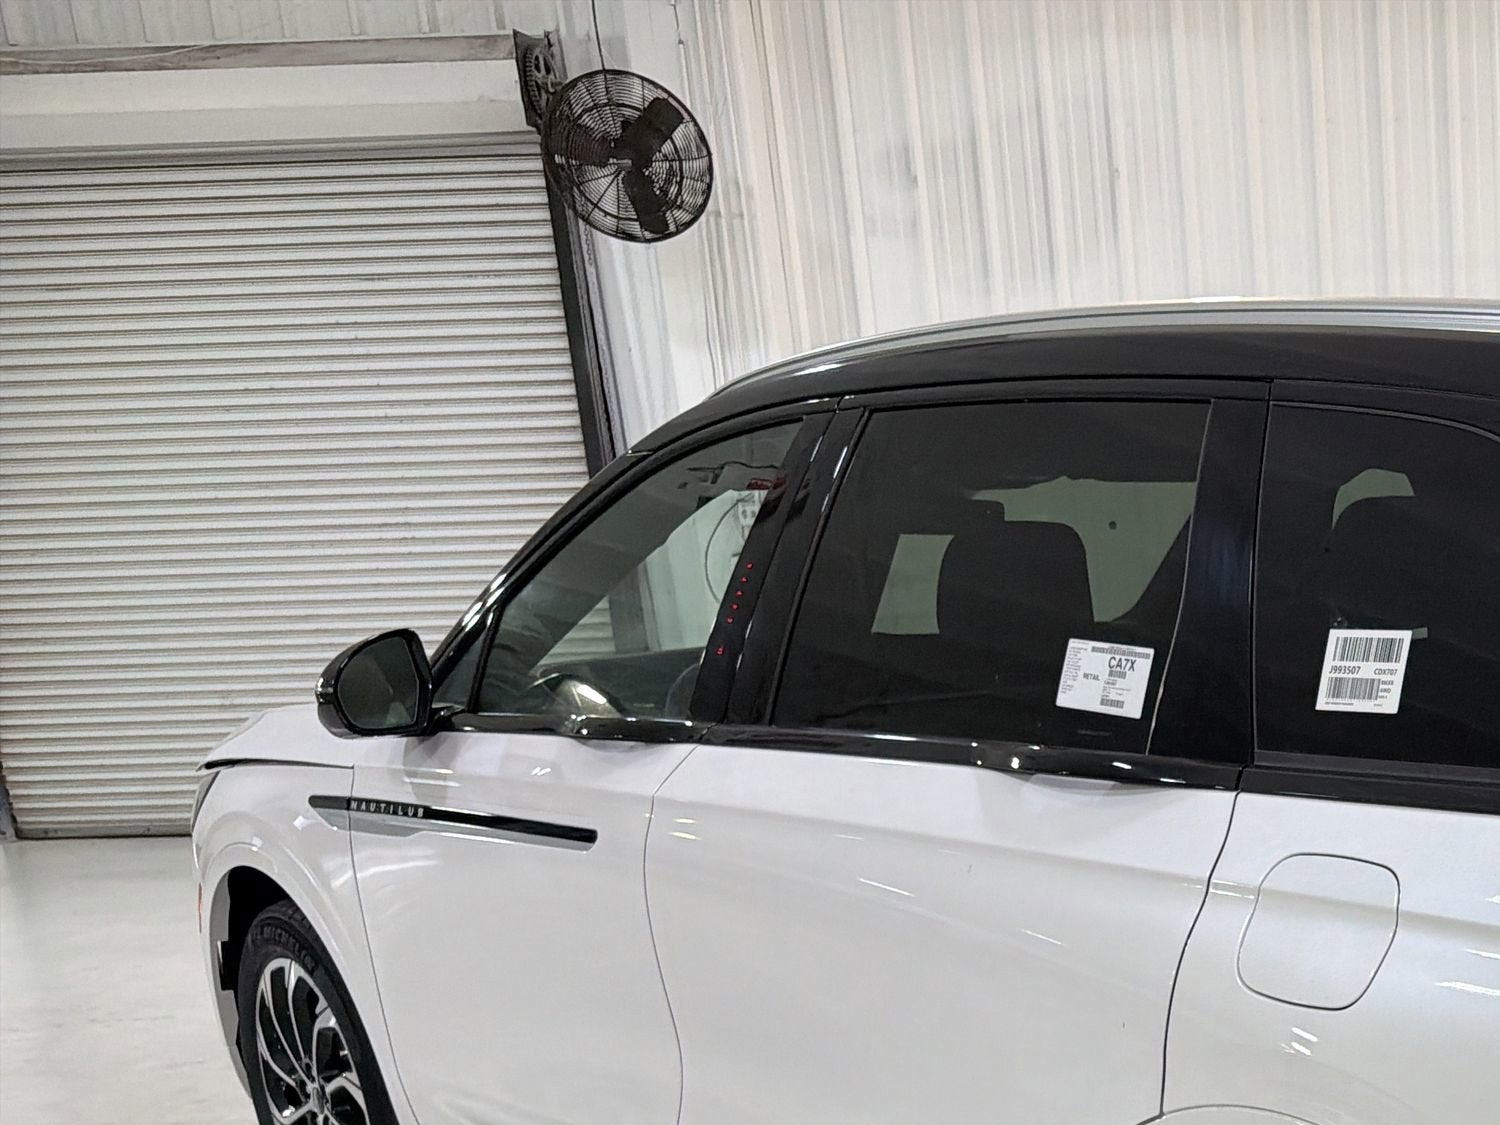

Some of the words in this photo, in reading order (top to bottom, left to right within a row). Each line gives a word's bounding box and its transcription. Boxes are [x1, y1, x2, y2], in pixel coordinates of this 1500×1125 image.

[1108, 656, 1137, 672] CA7X
[1329, 665, 1361, 675] J993507
[350, 800, 425, 818] NAUTILUS
